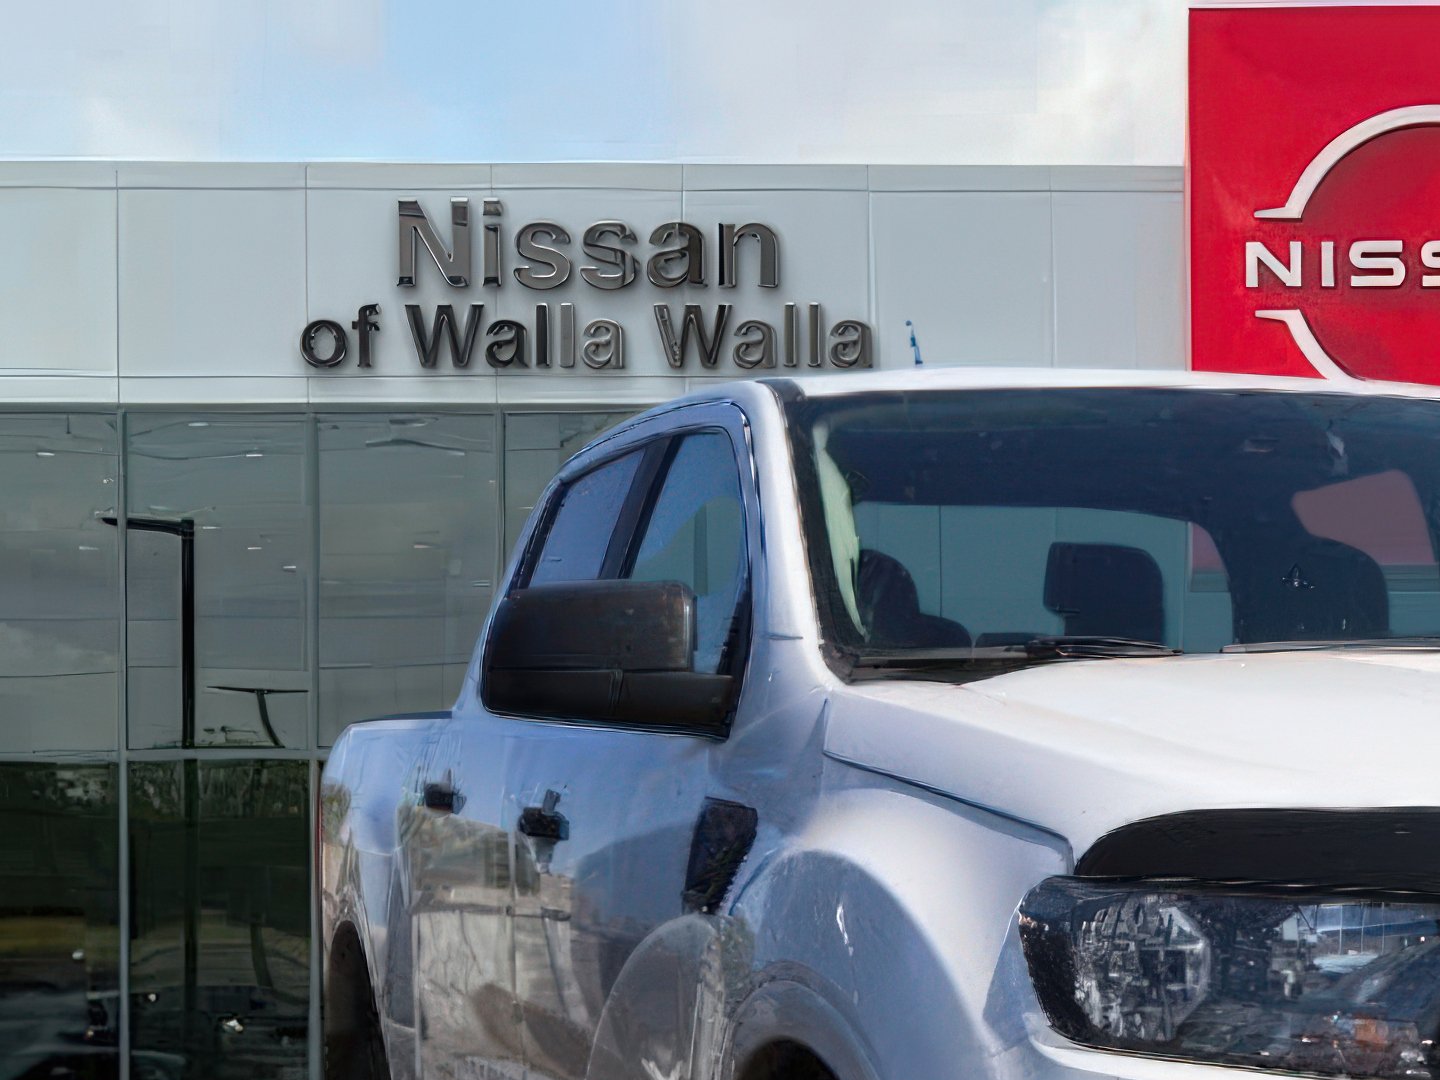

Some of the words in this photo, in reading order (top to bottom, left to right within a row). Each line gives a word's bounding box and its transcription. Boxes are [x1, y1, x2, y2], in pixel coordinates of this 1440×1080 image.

[397, 196, 779, 291] Nissan
[300, 303, 381, 369] of
[405, 301, 627, 369] Walla
[653, 301, 874, 369] Walla
